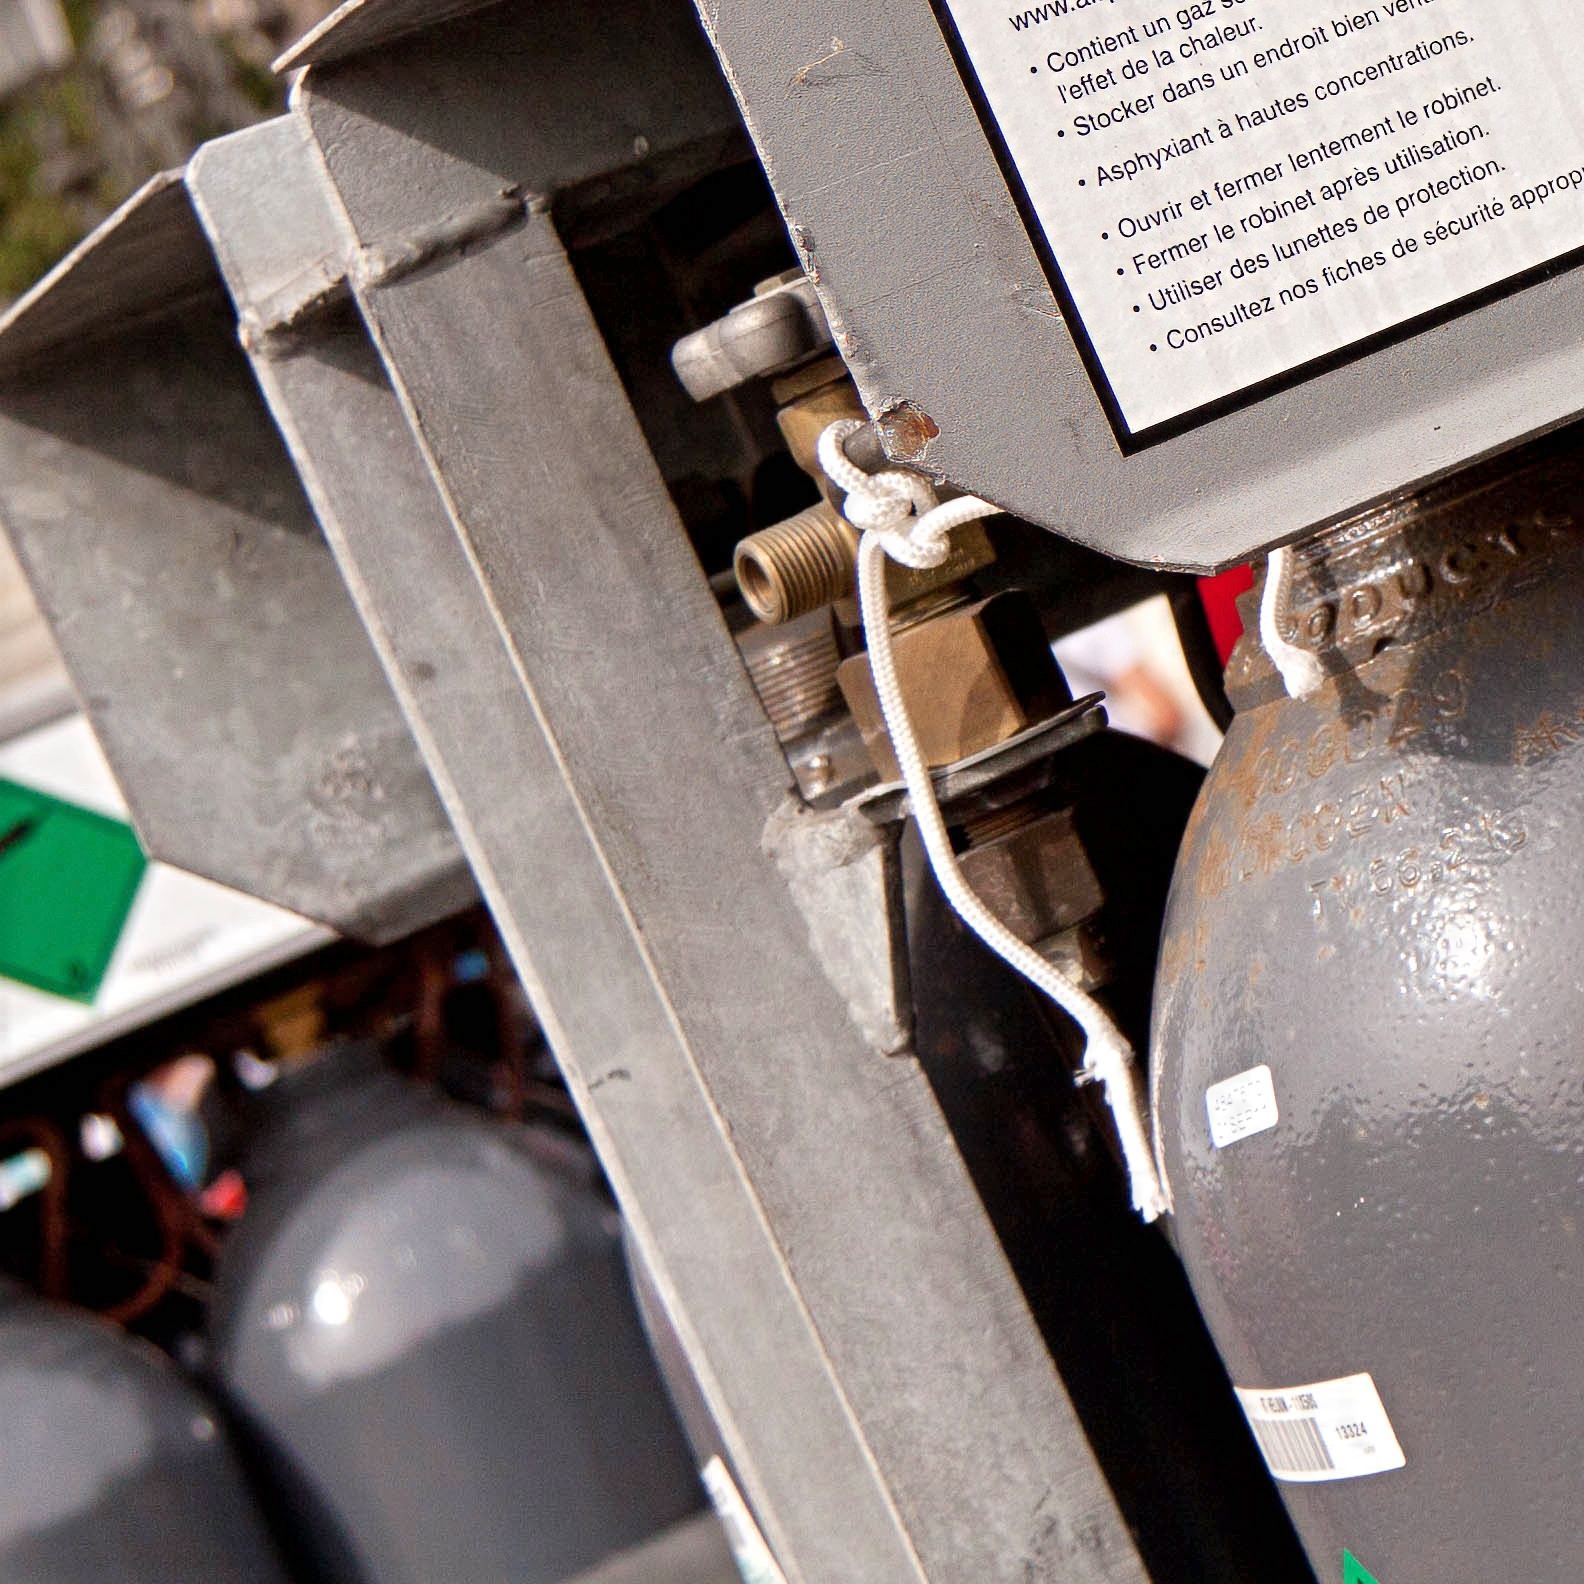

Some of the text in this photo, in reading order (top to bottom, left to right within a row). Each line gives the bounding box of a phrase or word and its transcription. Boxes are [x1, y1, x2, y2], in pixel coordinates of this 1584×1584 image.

[1045, 24, 1142, 74] Contient
[1140, 15, 1173, 39] un
[1056, 16, 1264, 105] l'effet de la chaleur.
[1072, 93, 1156, 138] Stocker
[1161, 72, 1217, 104] dans
[1218, 59, 1250, 82] un
[1252, 25, 1331, 70] endroit
[1329, 9, 1381, 39] bien
[1096, 29, 1476, 188] Asphyxiant à hautes concentrations.
[1116, 75, 1503, 240] Ouvrir et fermer lentement le robinet.
[1131, 123, 1491, 276] Fermer le robinet après utilisation.
[1146, 159, 1507, 312] Utiliser des lunettes de protection.
[1165, 295, 1276, 351] Consultez
[1277, 277, 1320, 307] nos
[1320, 250, 1388, 288] fiches
[1390, 236, 1420, 260] de
[1422, 195, 1506, 247] sécurité
[1334, 1420, 1369, 1441] 13324
